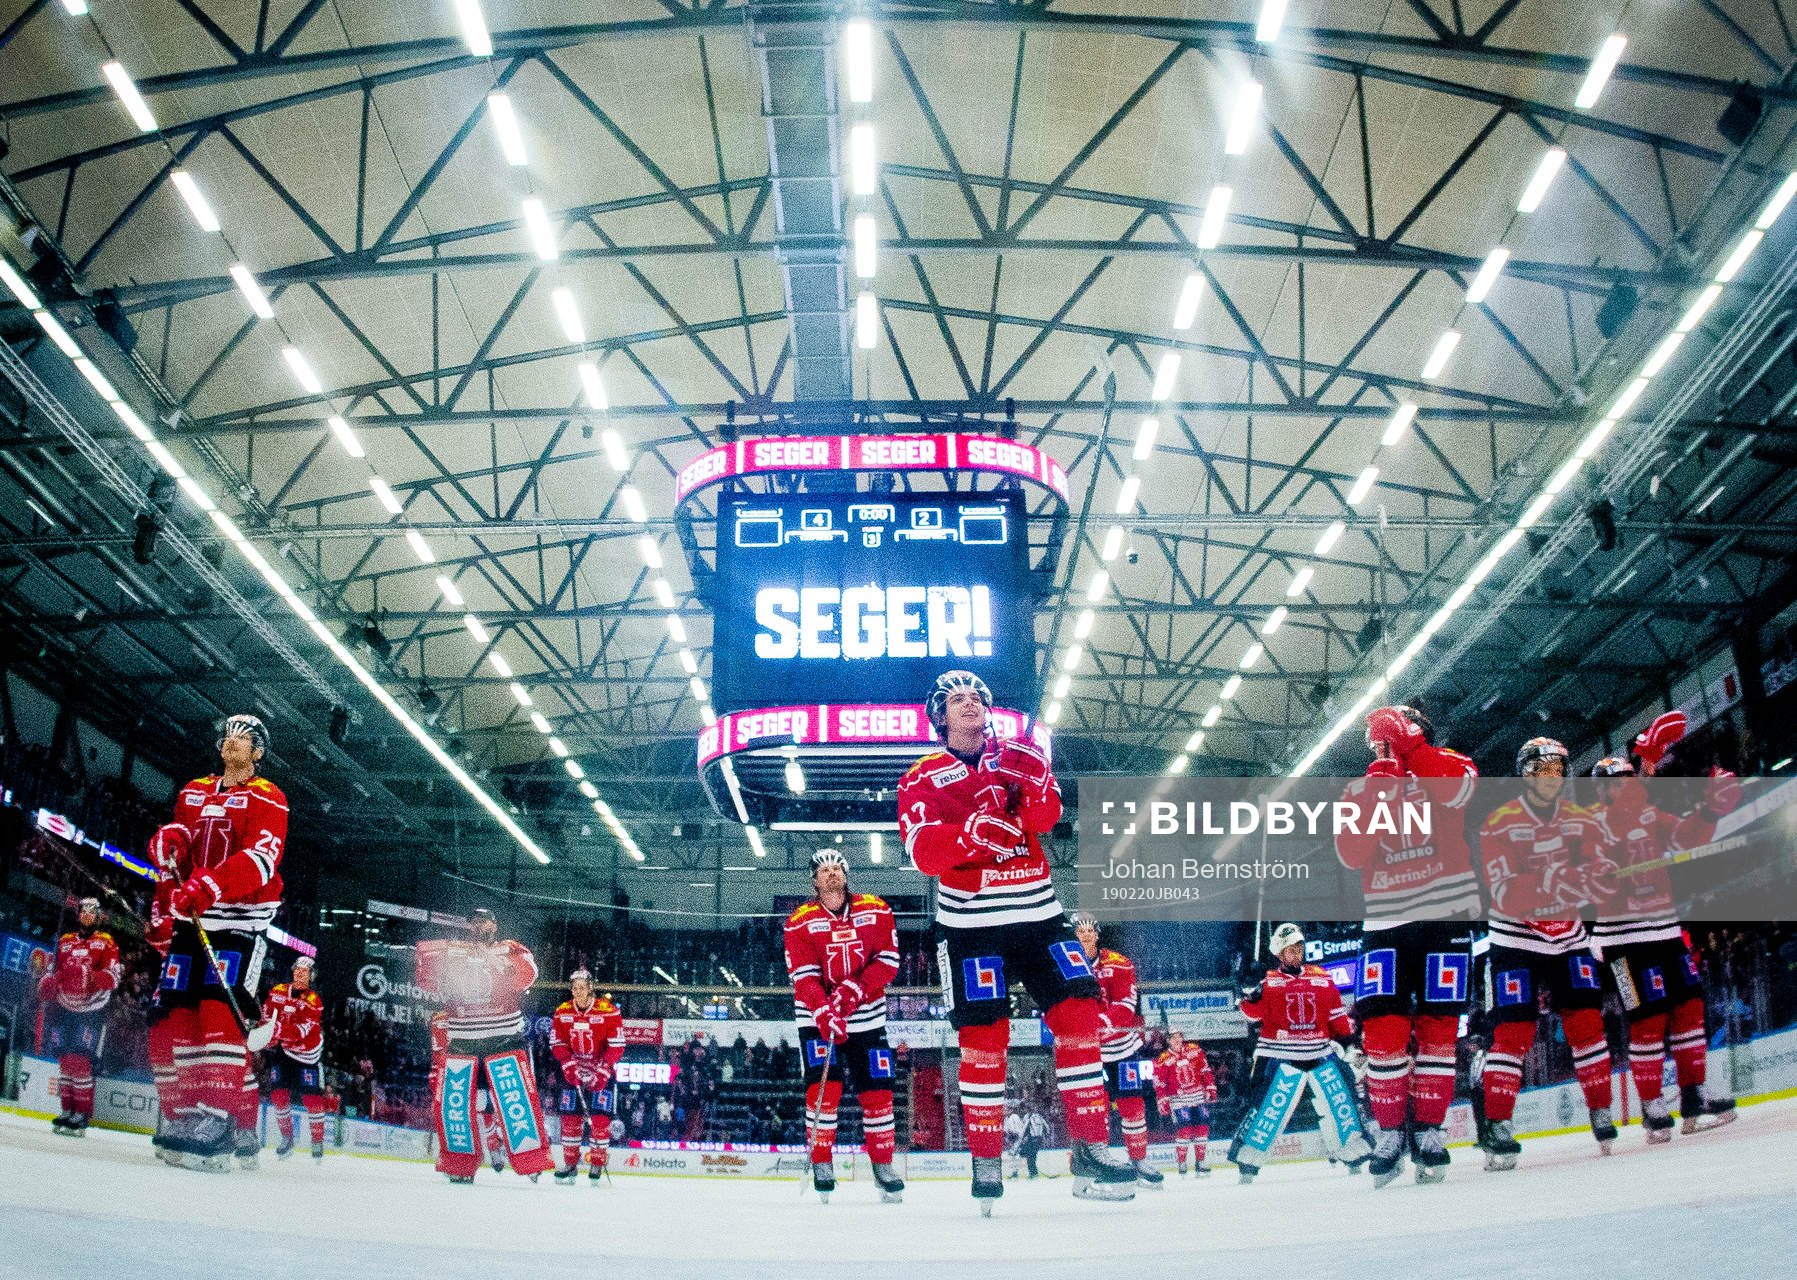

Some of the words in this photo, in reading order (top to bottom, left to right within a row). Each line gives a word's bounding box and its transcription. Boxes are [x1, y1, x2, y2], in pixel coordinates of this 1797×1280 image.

[680, 449, 727, 495] SEGER
[755, 441, 828, 466] SEGER
[861, 440, 936, 464] SEGER
[967, 439, 1035, 474] SEGER
[812, 513, 825, 527] 4
[859, 509, 888, 521] 0:00
[918, 512, 930, 526] 2
[754, 585, 993, 659] SEGER!
[737, 710, 808, 744] SEGER
[839, 709, 917, 737] SEGER
[901, 801, 926, 832] 17
[254, 829, 282, 860] 25
[1486, 855, 1512, 880] 51
[614, 1063, 671, 1084] EGER
[448, 1077, 468, 1147] HEROK
[495, 1063, 530, 1136] HEROK
[1251, 1078, 1296, 1145] HEROK
[1316, 1066, 1356, 1132] HEROK
[644, 1157, 686, 1169] Nolato
